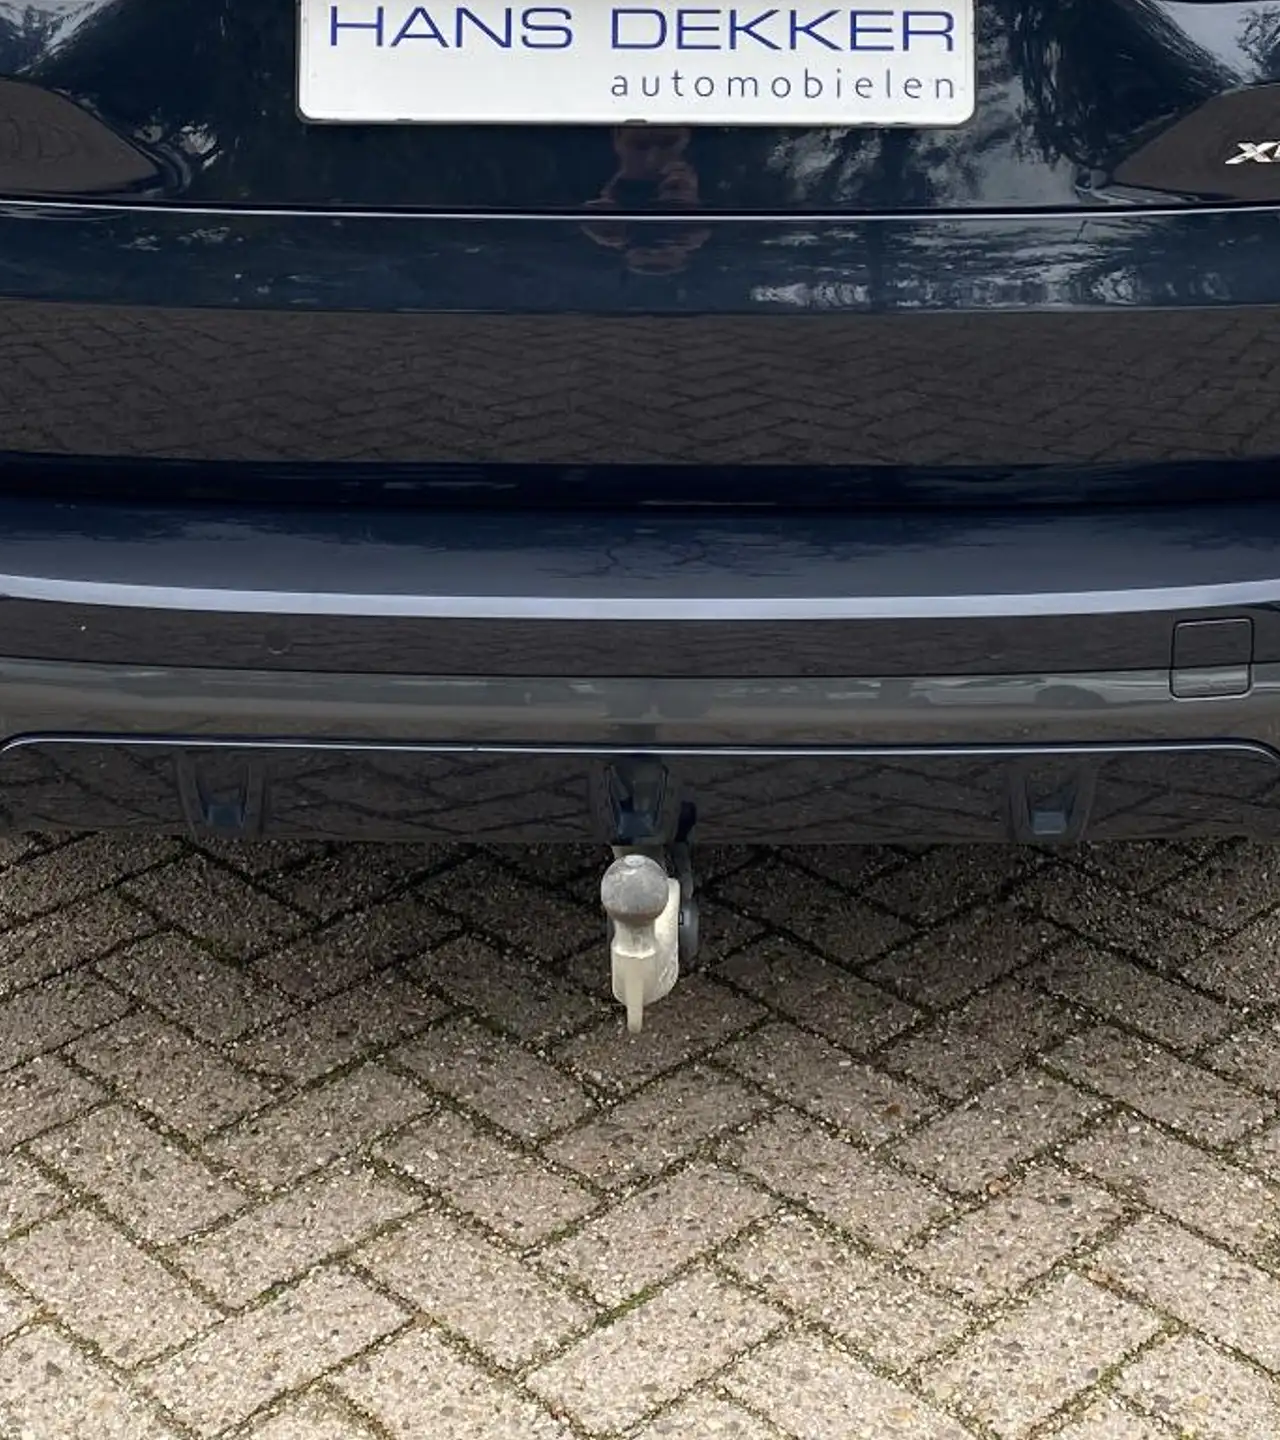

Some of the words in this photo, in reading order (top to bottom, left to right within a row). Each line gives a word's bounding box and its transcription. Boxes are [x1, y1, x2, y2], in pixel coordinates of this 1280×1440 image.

[330, 6, 573, 49] HANS
[611, 8, 954, 51] DEKKER
[611, 67, 954, 98] automobielen
